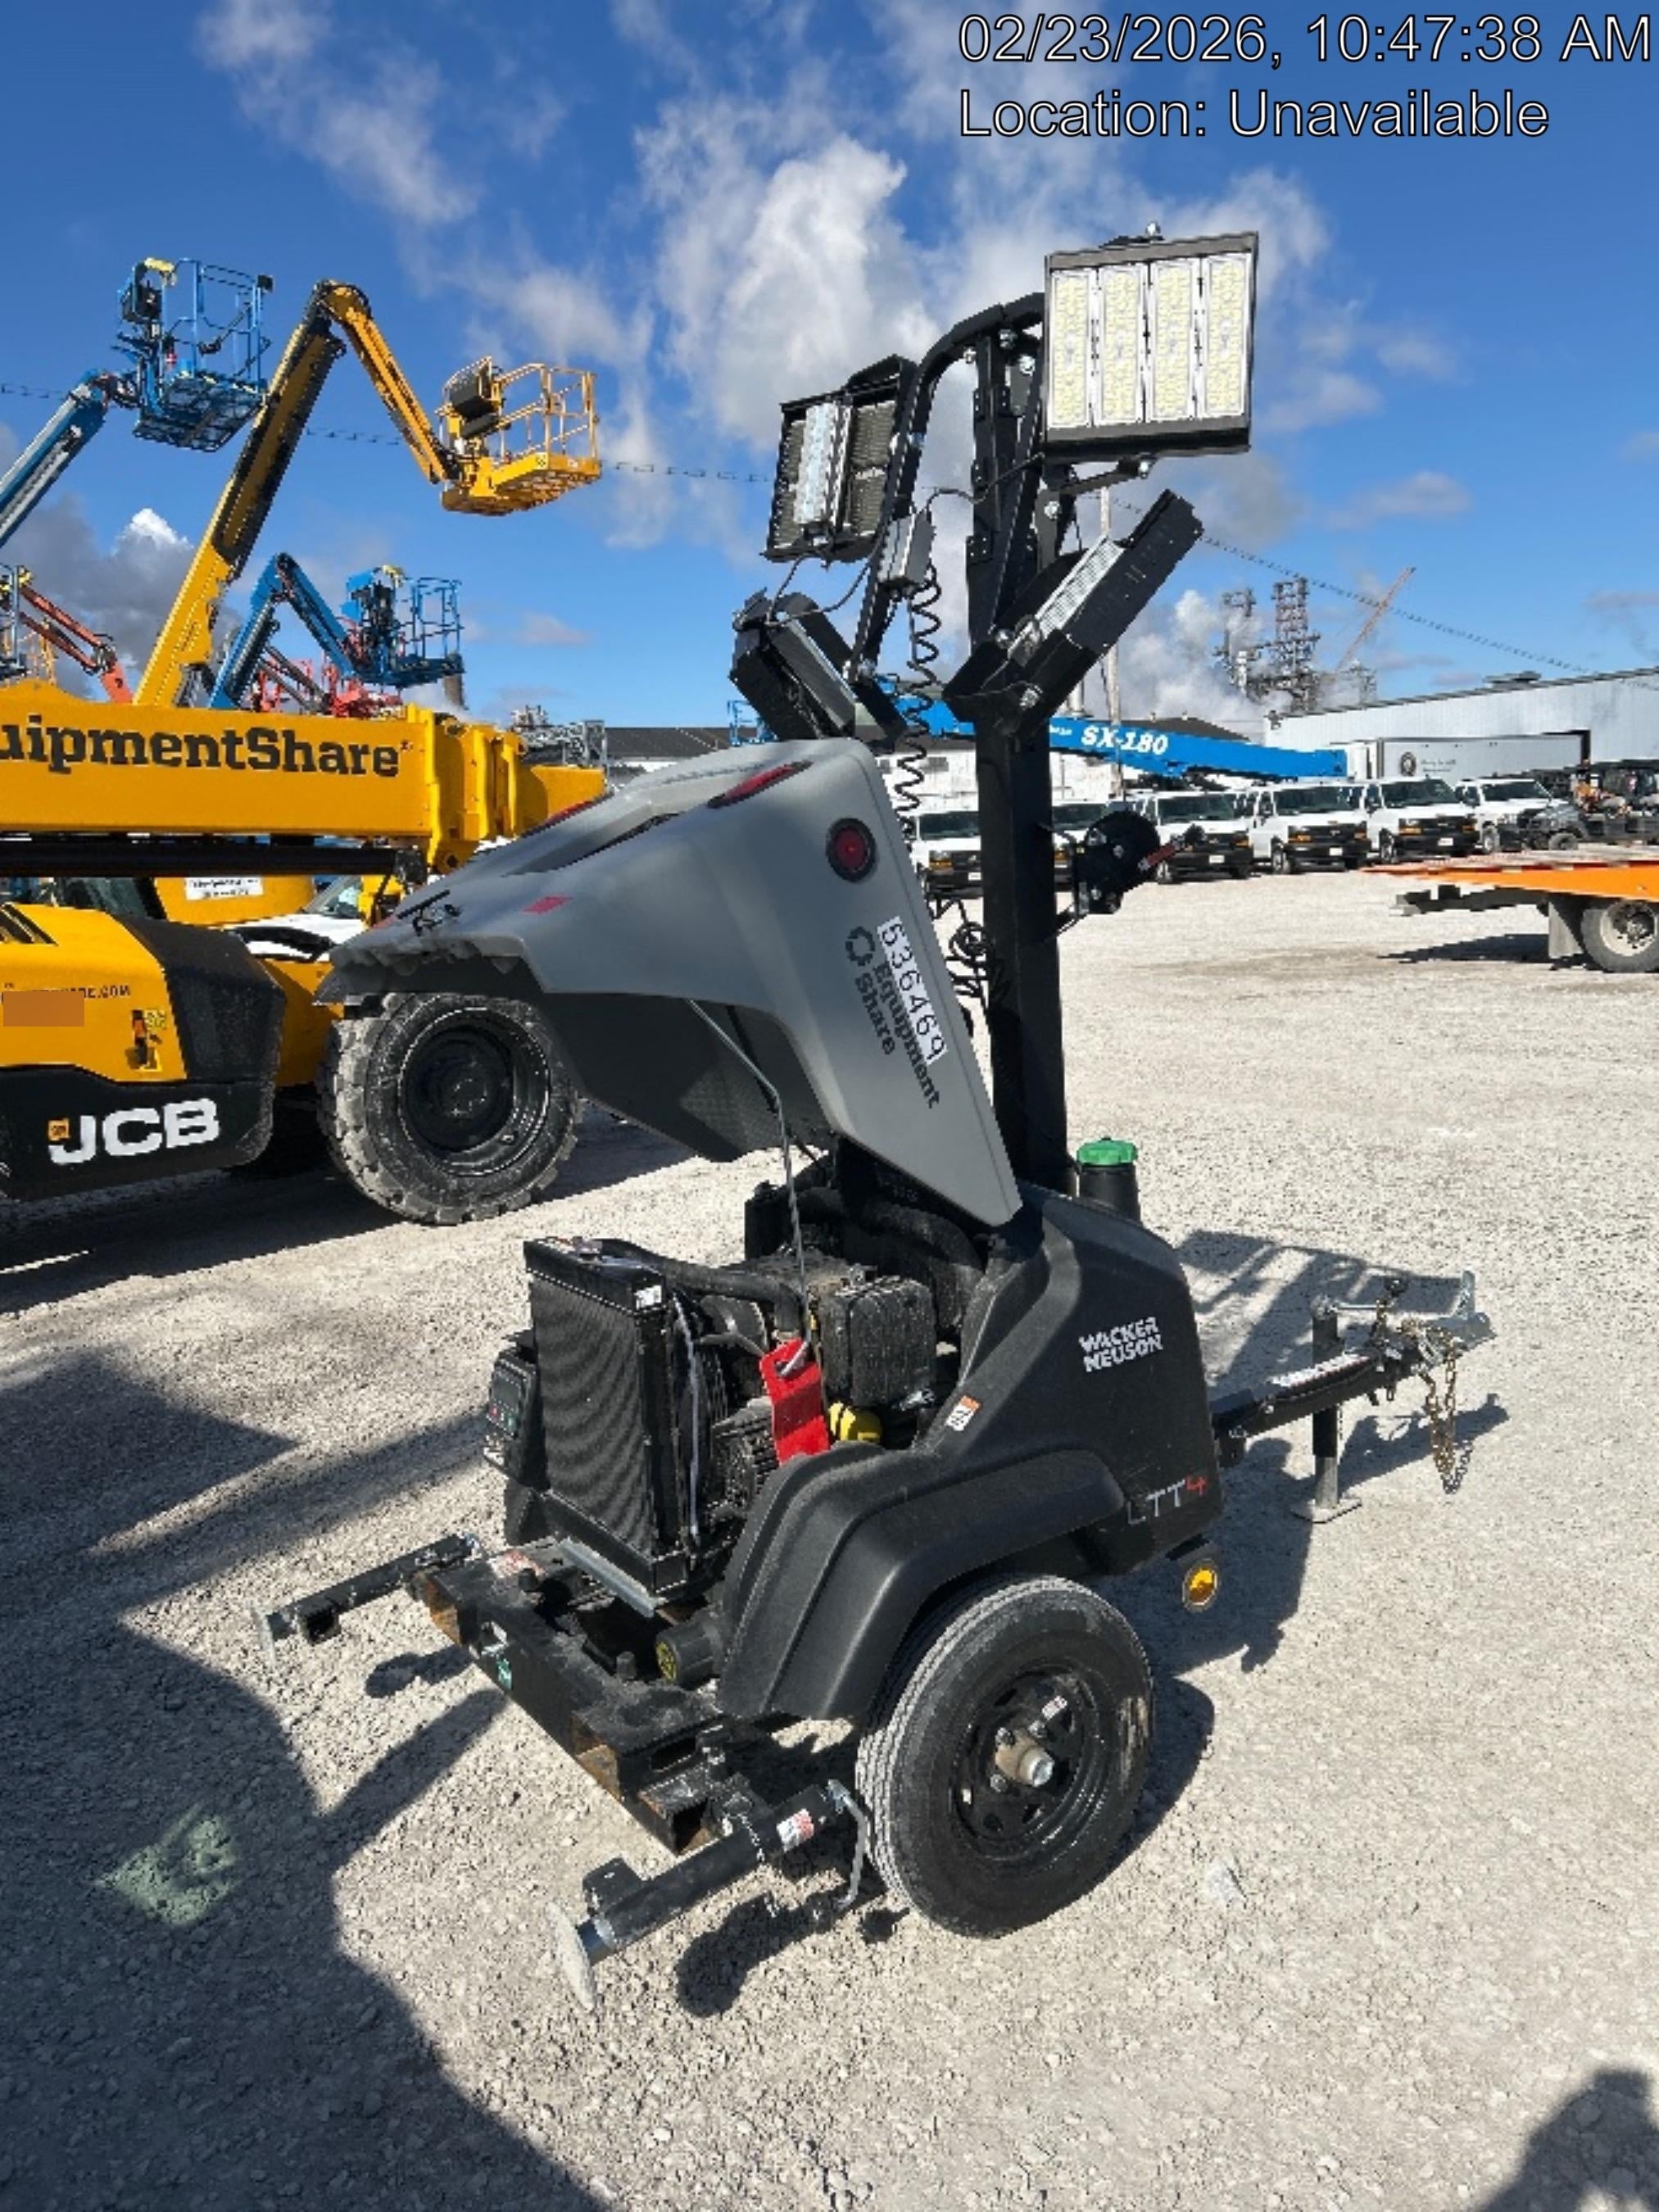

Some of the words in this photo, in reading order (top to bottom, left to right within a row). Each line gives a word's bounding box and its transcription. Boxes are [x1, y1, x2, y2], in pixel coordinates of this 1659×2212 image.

[1081, 724, 1169, 755] SX-180
[854, 972, 895, 1055] Share
[881, 922, 945, 1060] 536469
[48, 1098, 220, 1165] JCB
[1078, 1316, 1159, 1353] WACKER
[1083, 1333, 1164, 1373] NEUSON
